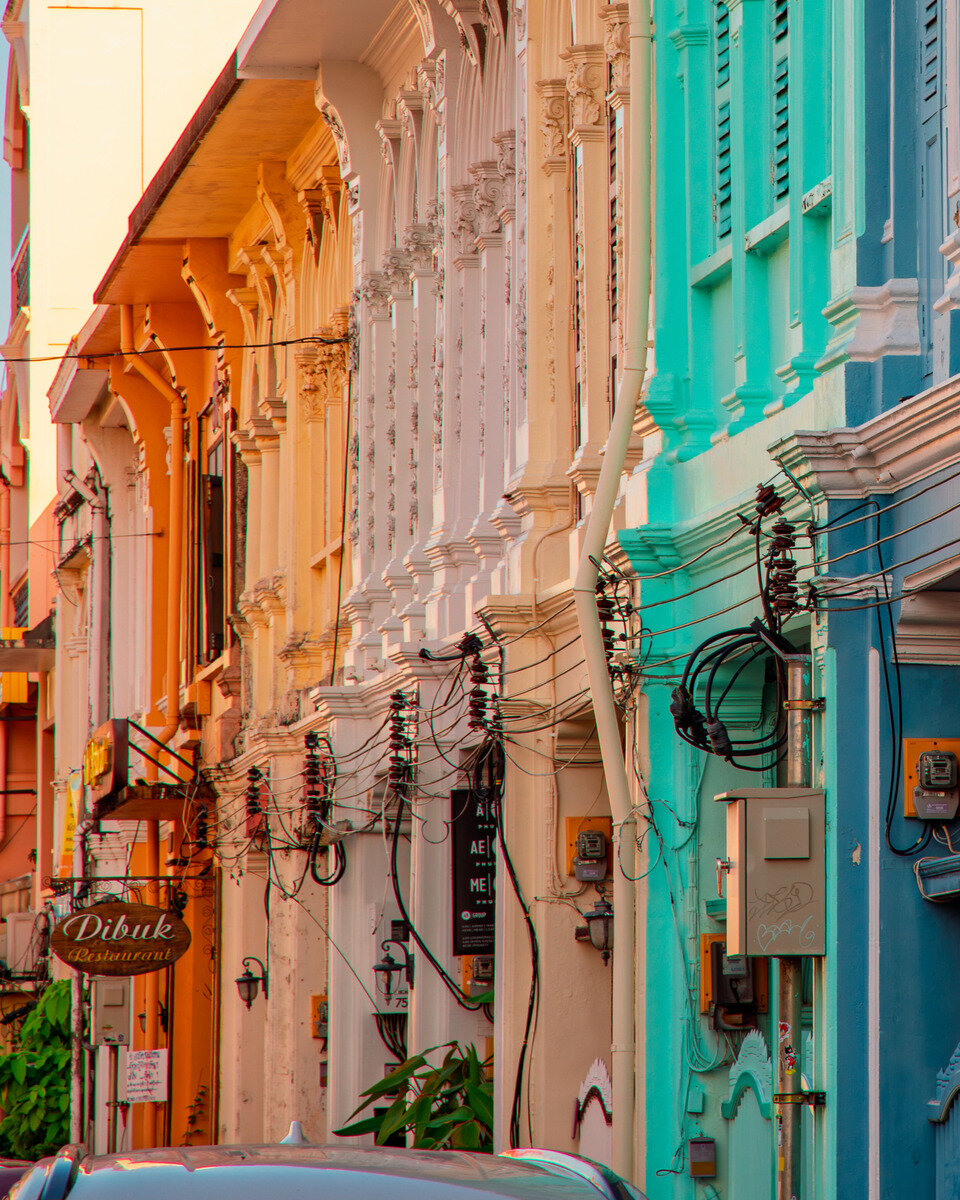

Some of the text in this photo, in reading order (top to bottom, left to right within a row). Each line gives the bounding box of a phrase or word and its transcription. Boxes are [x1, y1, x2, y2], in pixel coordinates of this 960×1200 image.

[470, 840, 486, 854] AE
[470, 877, 487, 892] ME
[63, 913, 175, 941] Dibuk
[68, 947, 172, 962] Restaurant
[395, 997, 409, 1008] 75
